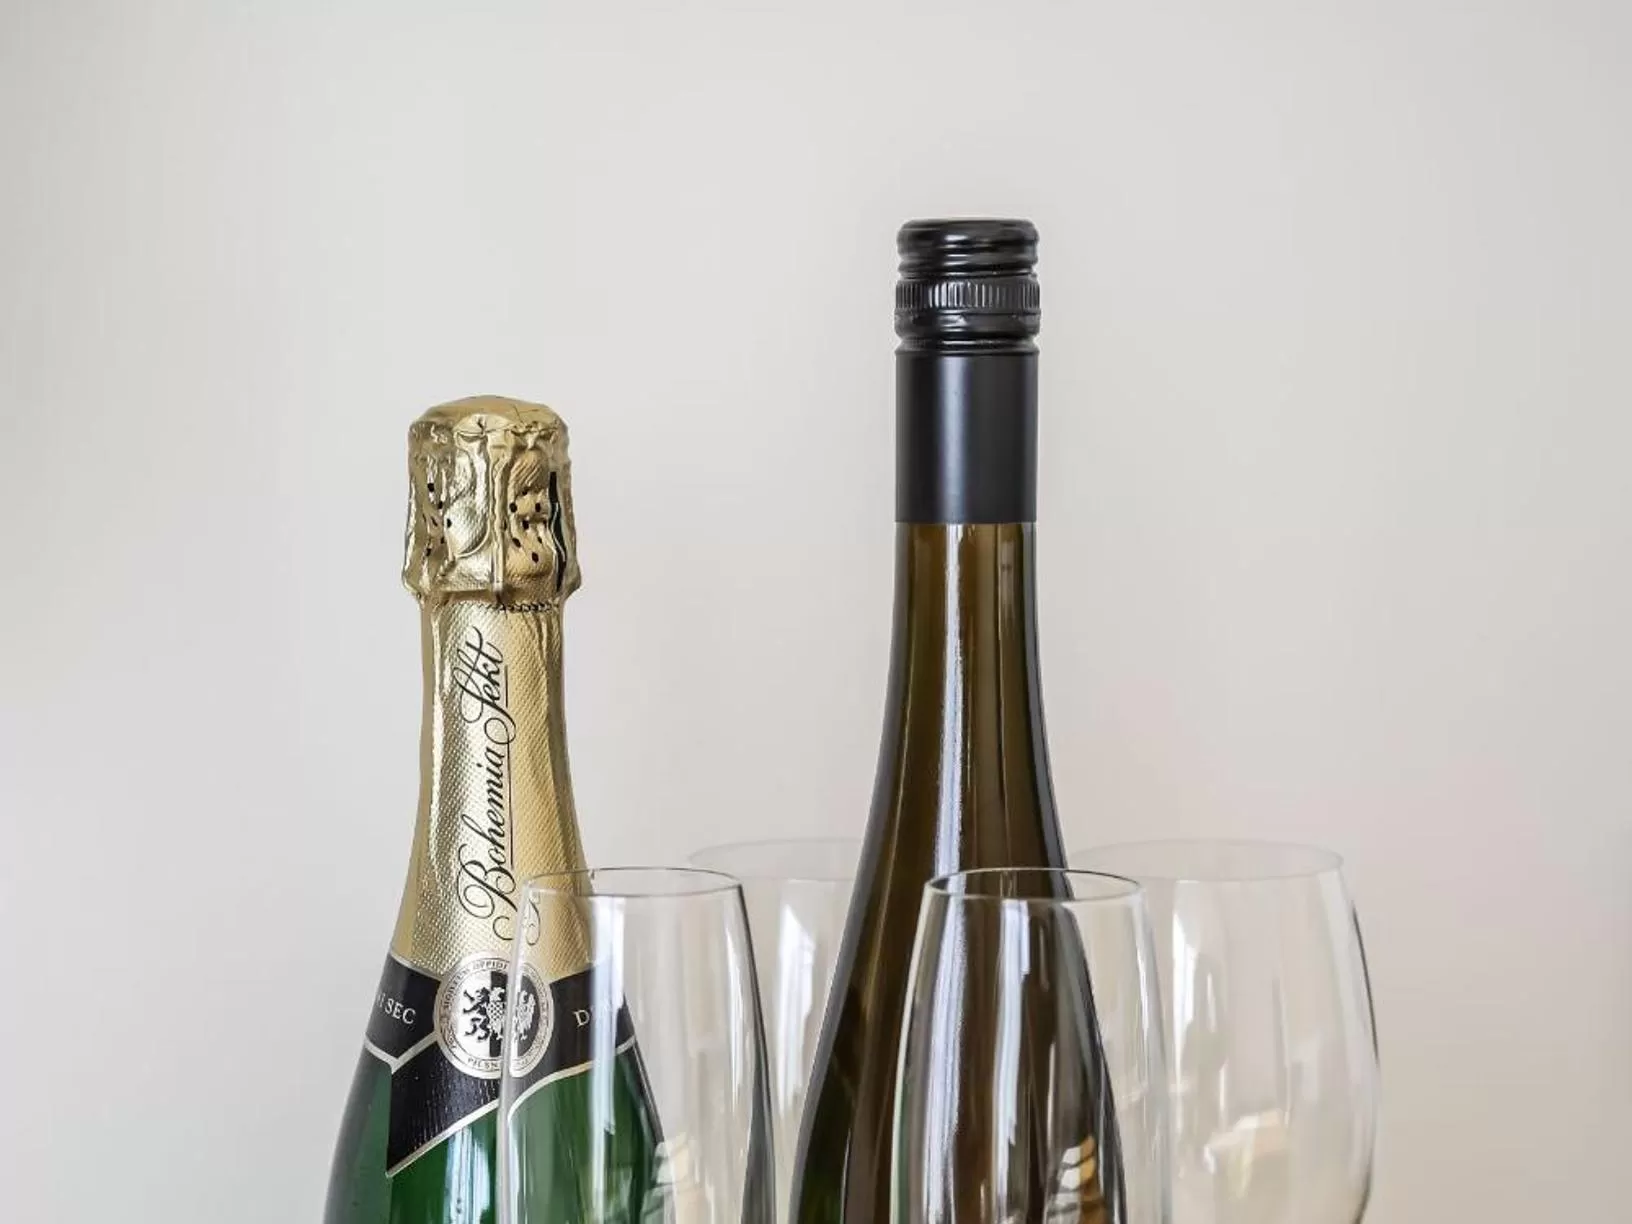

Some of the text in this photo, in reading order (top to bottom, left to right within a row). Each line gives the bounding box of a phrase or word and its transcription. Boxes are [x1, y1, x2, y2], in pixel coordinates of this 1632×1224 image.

[453, 625, 541, 946] Bohemia Sekt
[385, 998, 416, 1024] SEC
